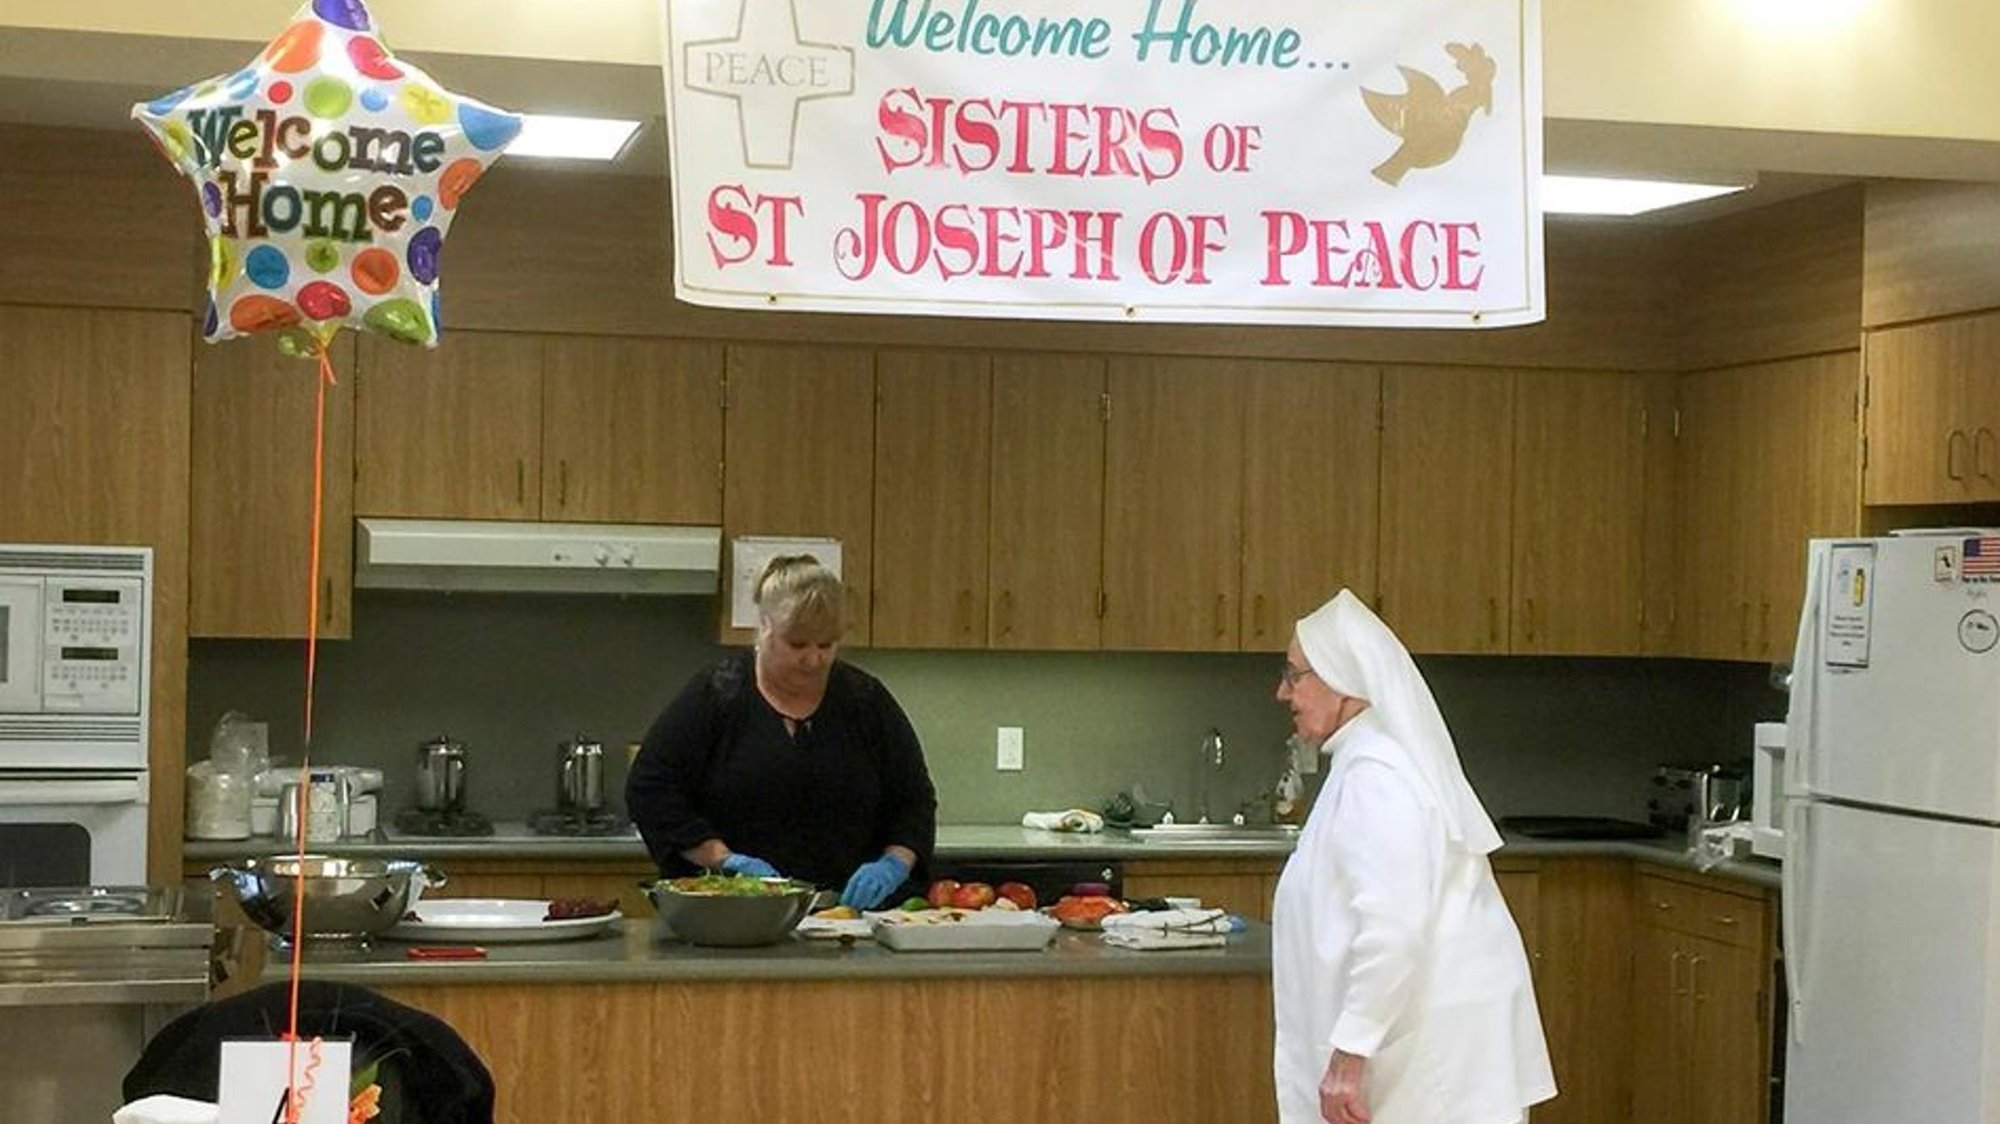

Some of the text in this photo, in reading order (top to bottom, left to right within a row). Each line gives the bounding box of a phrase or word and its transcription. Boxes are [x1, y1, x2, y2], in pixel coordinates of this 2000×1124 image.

[866, 0, 1110, 59] Welcome
[705, 52, 829, 87] PEACE
[187, 105, 445, 175] Welcome
[876, 86, 1263, 186] SISTERS OF
[220, 171, 407, 242] Home
[707, 184, 1485, 291] ST JOSEPH OF PEACE
